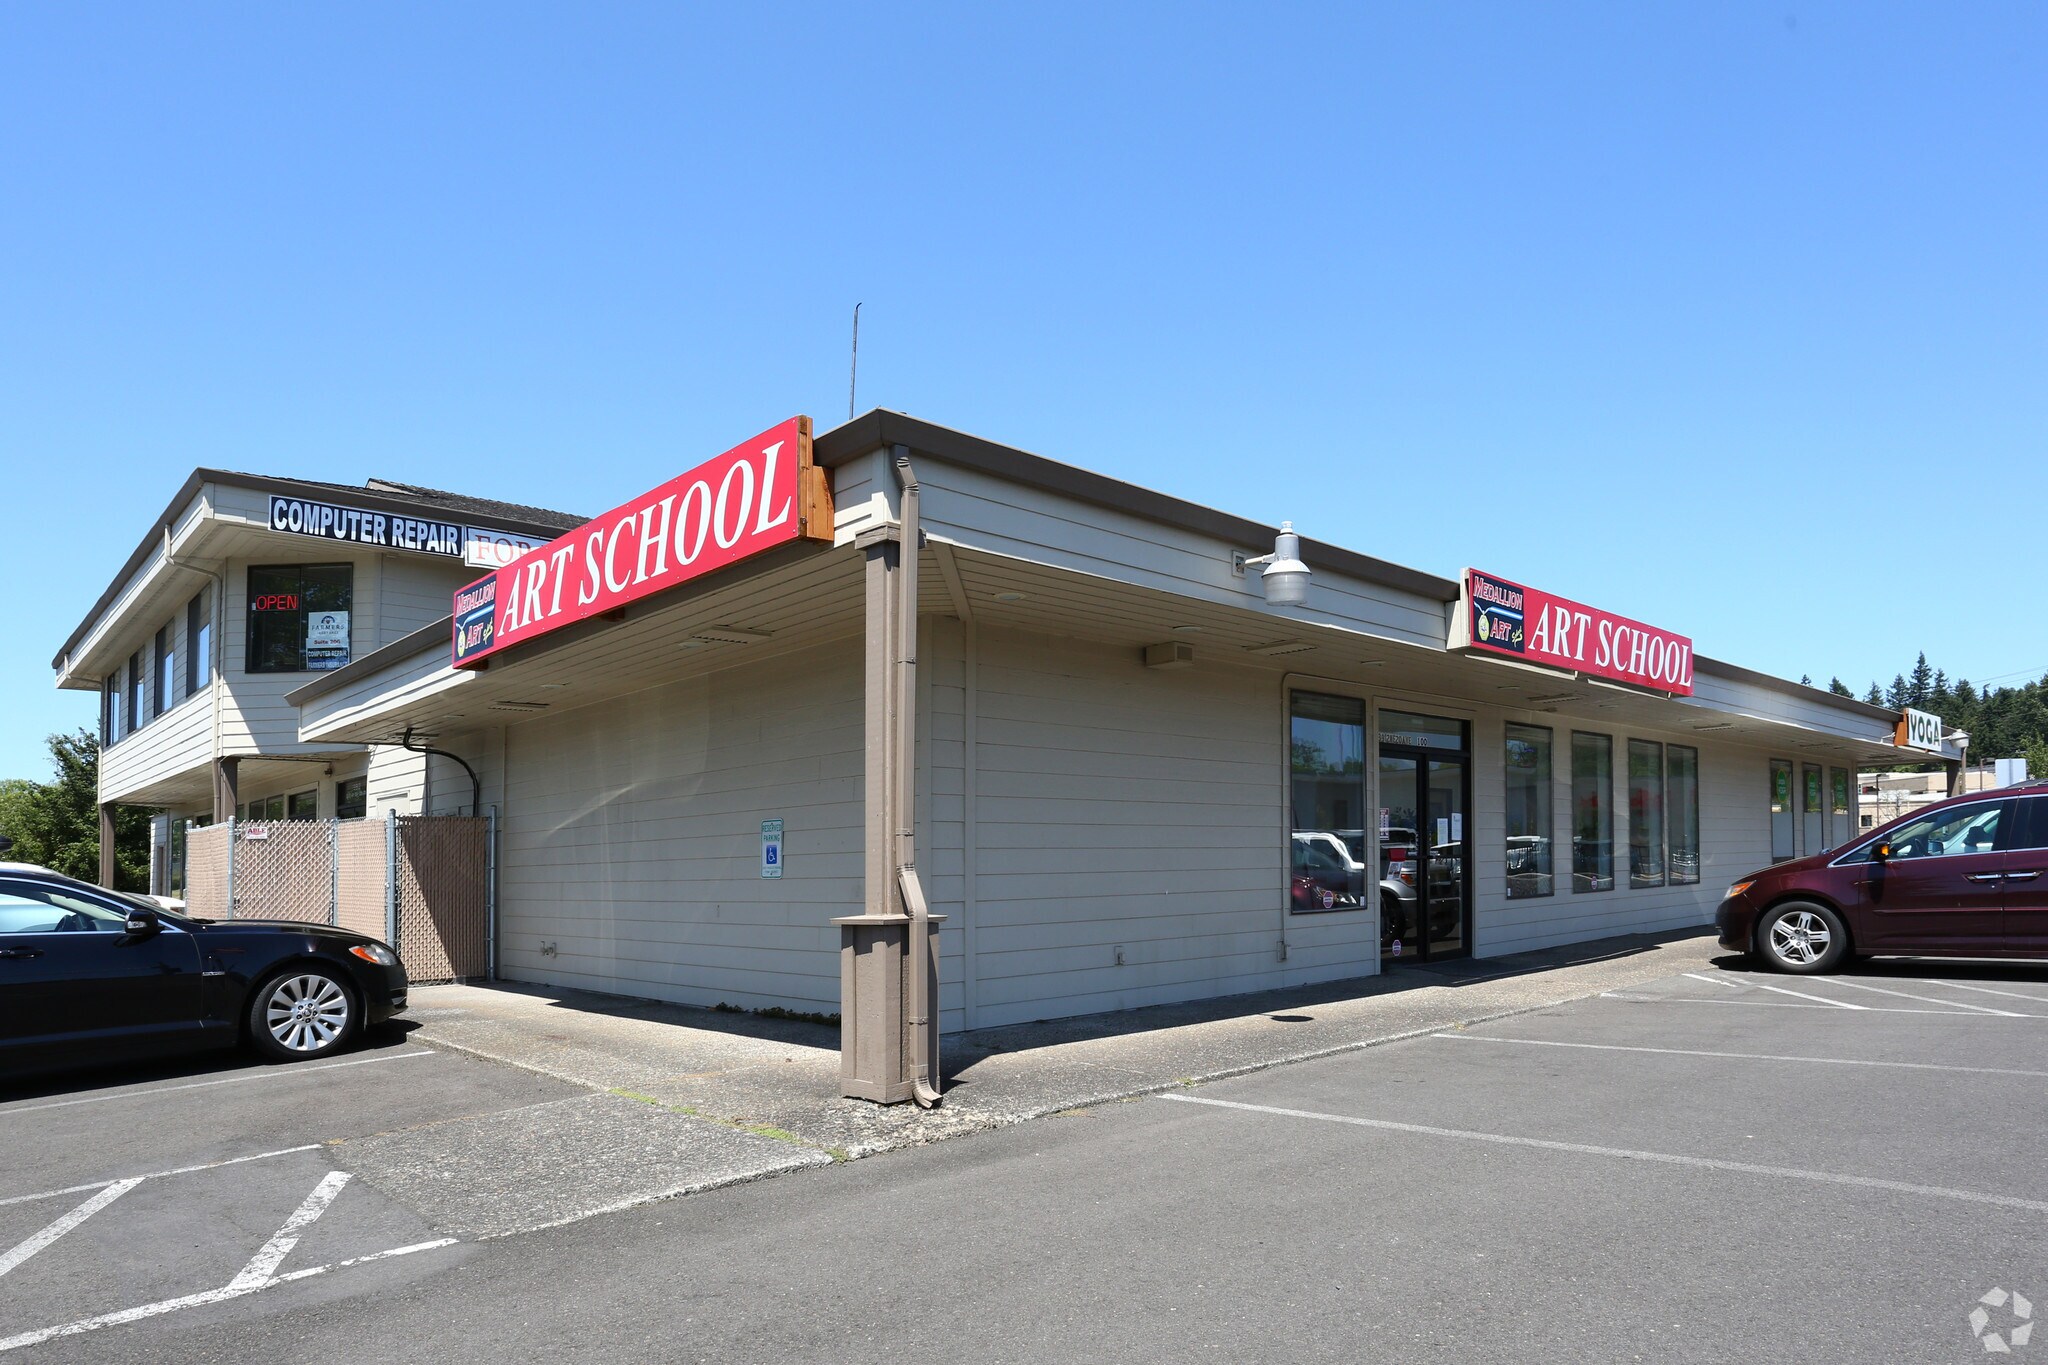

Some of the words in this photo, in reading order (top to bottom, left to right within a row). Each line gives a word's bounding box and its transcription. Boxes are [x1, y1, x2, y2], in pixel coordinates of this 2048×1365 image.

[273, 498, 386, 545] COMPUTER
[391, 519, 459, 555] REPAIR
[497, 543, 574, 637] ART
[578, 439, 792, 607] SCHOOL
[256, 595, 298, 610] OPEN
[456, 580, 496, 618] MEDALLION
[1473, 575, 1523, 611] MEDALLION
[465, 622, 484, 650] ART
[1490, 617, 1512, 642] ART
[1528, 602, 1592, 661] ART
[1595, 619, 1692, 688] SCHOOL
[1417, 737, 1427, 747] 100
[1910, 713, 1940, 747] YOGA
